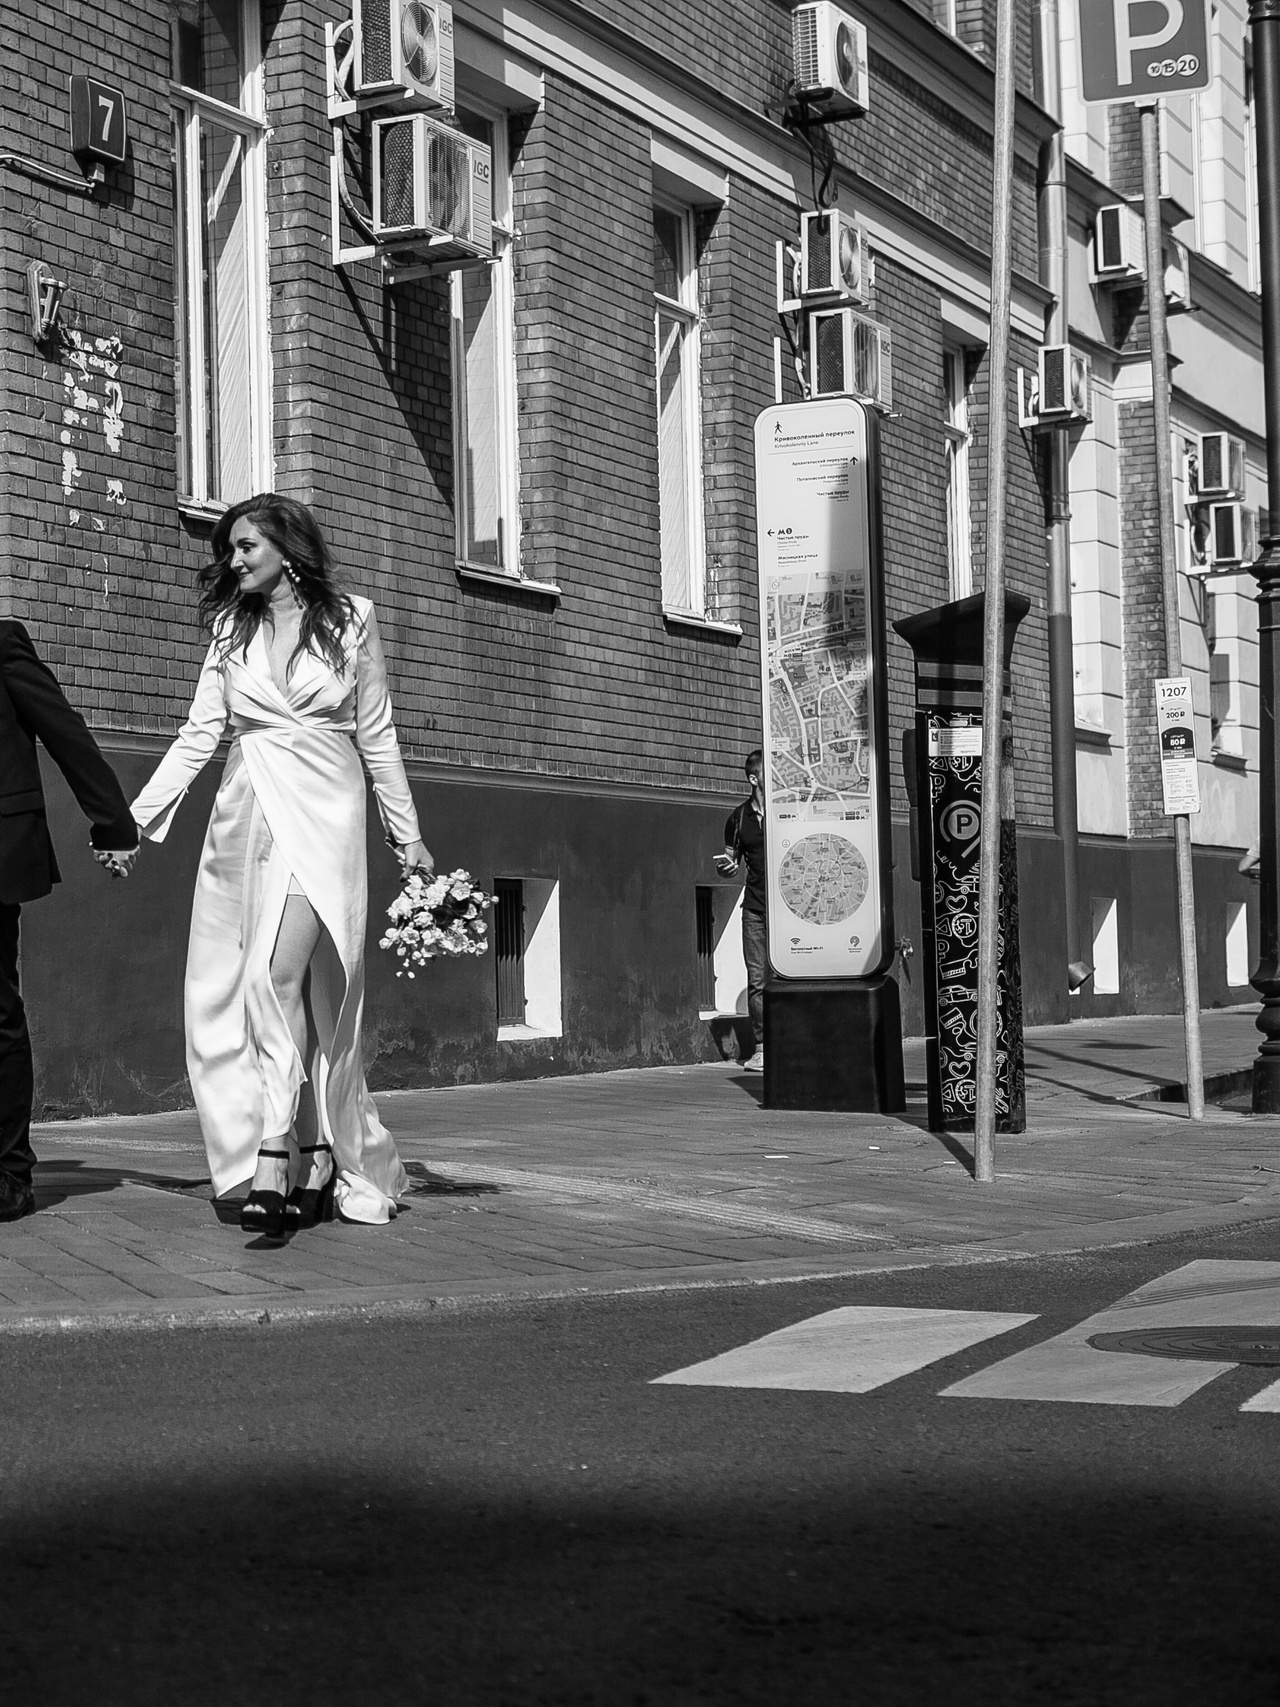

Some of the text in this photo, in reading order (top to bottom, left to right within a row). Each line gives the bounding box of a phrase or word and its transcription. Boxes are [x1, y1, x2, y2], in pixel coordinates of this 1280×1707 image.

[439, 17, 453, 35] IGC
[1114, 0, 1184, 86] P
[1163, 62, 1175, 73] 15
[1179, 58, 1197, 73] 20
[98, 94, 114, 142] 7
[473, 159, 490, 179] IGC
[881, 340, 891, 353] IGC
[774, 432, 824, 443] Кривоколенный
[1161, 687, 1187, 697] 1207
[956, 814, 973, 834] P
